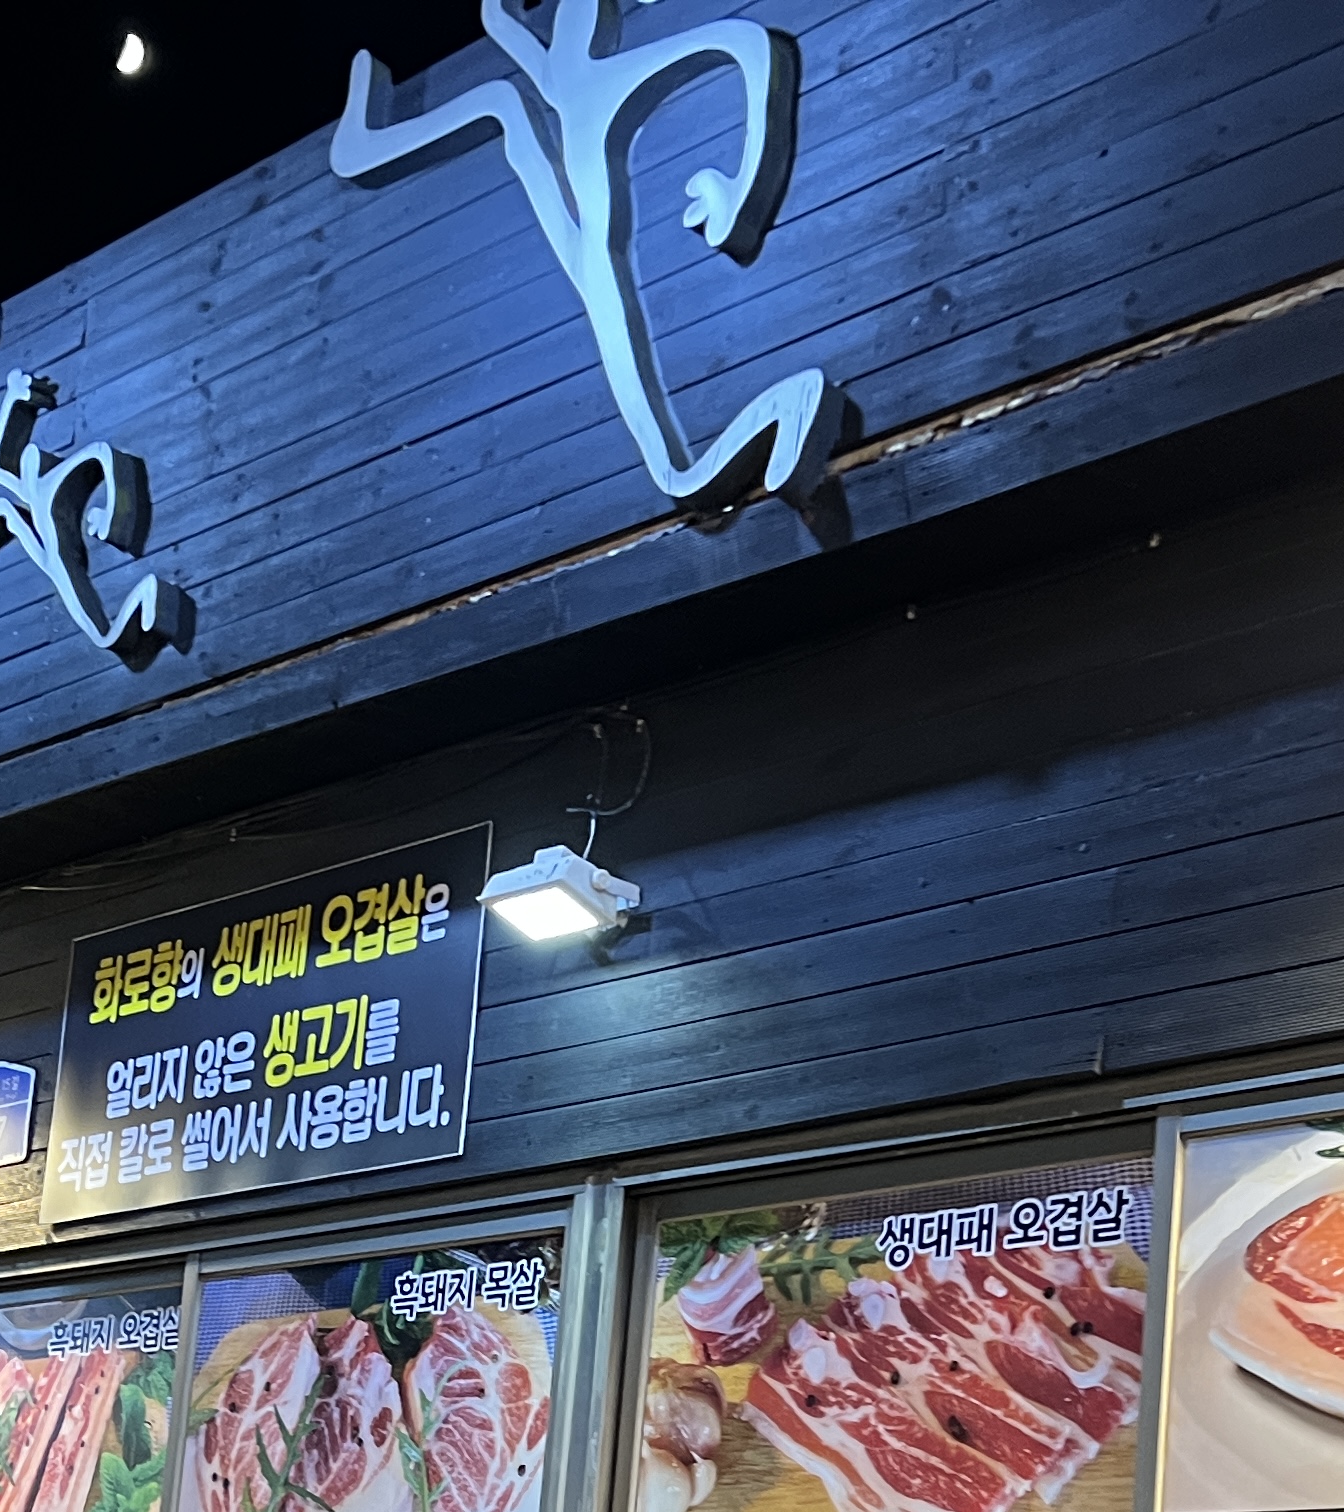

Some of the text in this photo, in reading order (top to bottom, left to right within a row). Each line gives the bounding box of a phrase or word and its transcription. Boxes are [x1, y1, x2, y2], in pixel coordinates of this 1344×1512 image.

[88, 873, 451, 1025] 화로향의 생대패 오겹살은
[105, 994, 401, 1120] 얼리지 않은 생고기를
[57, 1063, 451, 1192] 직접 칼로 썰어서 사용합니다.
[877, 1187, 1131, 1270] 생대패 오겹살
[46, 1314, 116, 1360] 흑돼지
[390, 1257, 545, 1321] 흑돼지 목살
